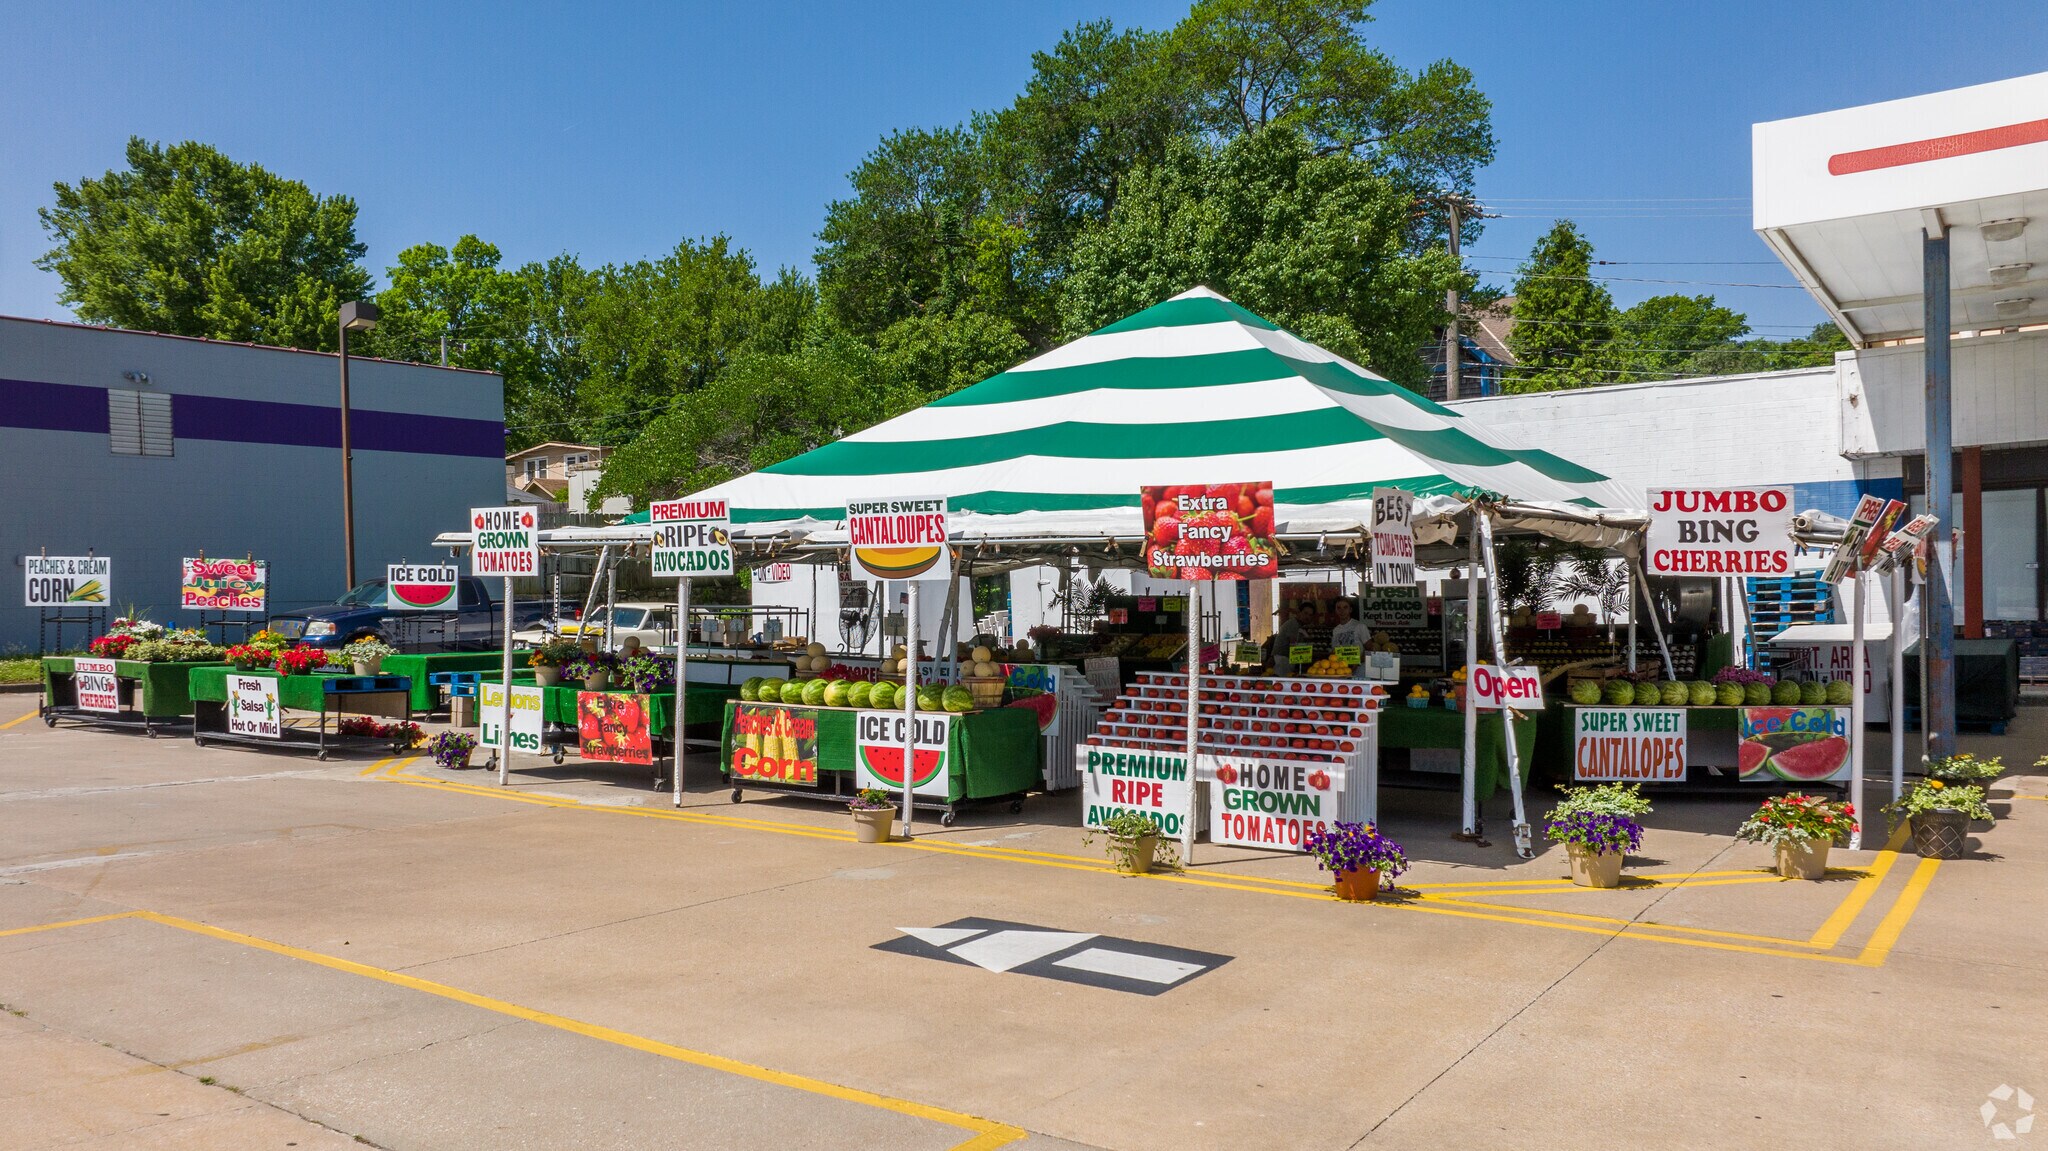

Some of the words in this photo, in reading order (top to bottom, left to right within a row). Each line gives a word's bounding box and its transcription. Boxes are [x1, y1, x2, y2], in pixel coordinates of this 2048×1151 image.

[652, 501, 726, 520] PREMIUM
[849, 502, 889, 515] SUPER
[891, 500, 943, 513] SWEET
[1178, 495, 1228, 511] Extra
[1375, 496, 1412, 526] BEST
[1653, 490, 1787, 513] JUMBO
[485, 511, 520, 530] HOME
[850, 513, 945, 545] CANTALOUPES
[478, 531, 529, 549] GROWN
[665, 524, 708, 548] RIPE
[1178, 523, 1232, 543] Fancy
[1677, 519, 1760, 544] BING
[1374, 532, 1412, 558] TOMATOES
[28, 559, 65, 574] PEACHES
[67, 559, 76, 574] &
[78, 559, 107, 575] CREAM
[192, 559, 257, 576] Sweet
[477, 551, 533, 573] TOMATOES
[653, 550, 730, 572] AVOCADOS
[1152, 550, 1270, 568] Strawberries
[1653, 549, 1788, 574] CHERRIES
[391, 567, 414, 582] ICE
[417, 568, 455, 583] COLD
[772, 564, 790, 580] VIDEO
[1376, 562, 1388, 584] IN
[1390, 562, 1415, 584] TOWN
[29, 578, 75, 603] CORN
[186, 577, 263, 592] Juicy
[184, 591, 261, 608] Peaches
[1363, 599, 1422, 611] Lettuce
[1363, 612, 1383, 621] Kept
[1385, 612, 1393, 620] In
[1395, 612, 1422, 620] Cooler
[76, 662, 114, 673] JUMBO
[1830, 646, 1871, 669] ARA
[83, 675, 108, 692] BING
[238, 679, 261, 691] Fresh
[1011, 667, 1056, 693] Cold
[1474, 667, 1538, 705] Open
[80, 693, 117, 709] CHERRIES
[241, 699, 264, 712] Salsa
[231, 719, 245, 731] Hot
[247, 720, 257, 732] Or
[259, 721, 278, 734] Mild
[735, 705, 773, 736] Peaches
[775, 708, 783, 737] &
[784, 709, 815, 740] Cream
[860, 716, 890, 741] ICE
[1581, 711, 1628, 732] SUPER
[1633, 711, 1681, 732] SWEET
[1743, 716, 1781, 739] Ice
[1790, 711, 1846, 737] Cold
[582, 740, 649, 760] Strawberries
[1577, 736, 1684, 779] CANTALOPES
[733, 746, 815, 782] Corn
[1240, 763, 1306, 792] HOME
[1112, 778, 1163, 808] RIPE
[1223, 788, 1321, 817] GROWN
[1221, 812, 1328, 847] TOMATOES
